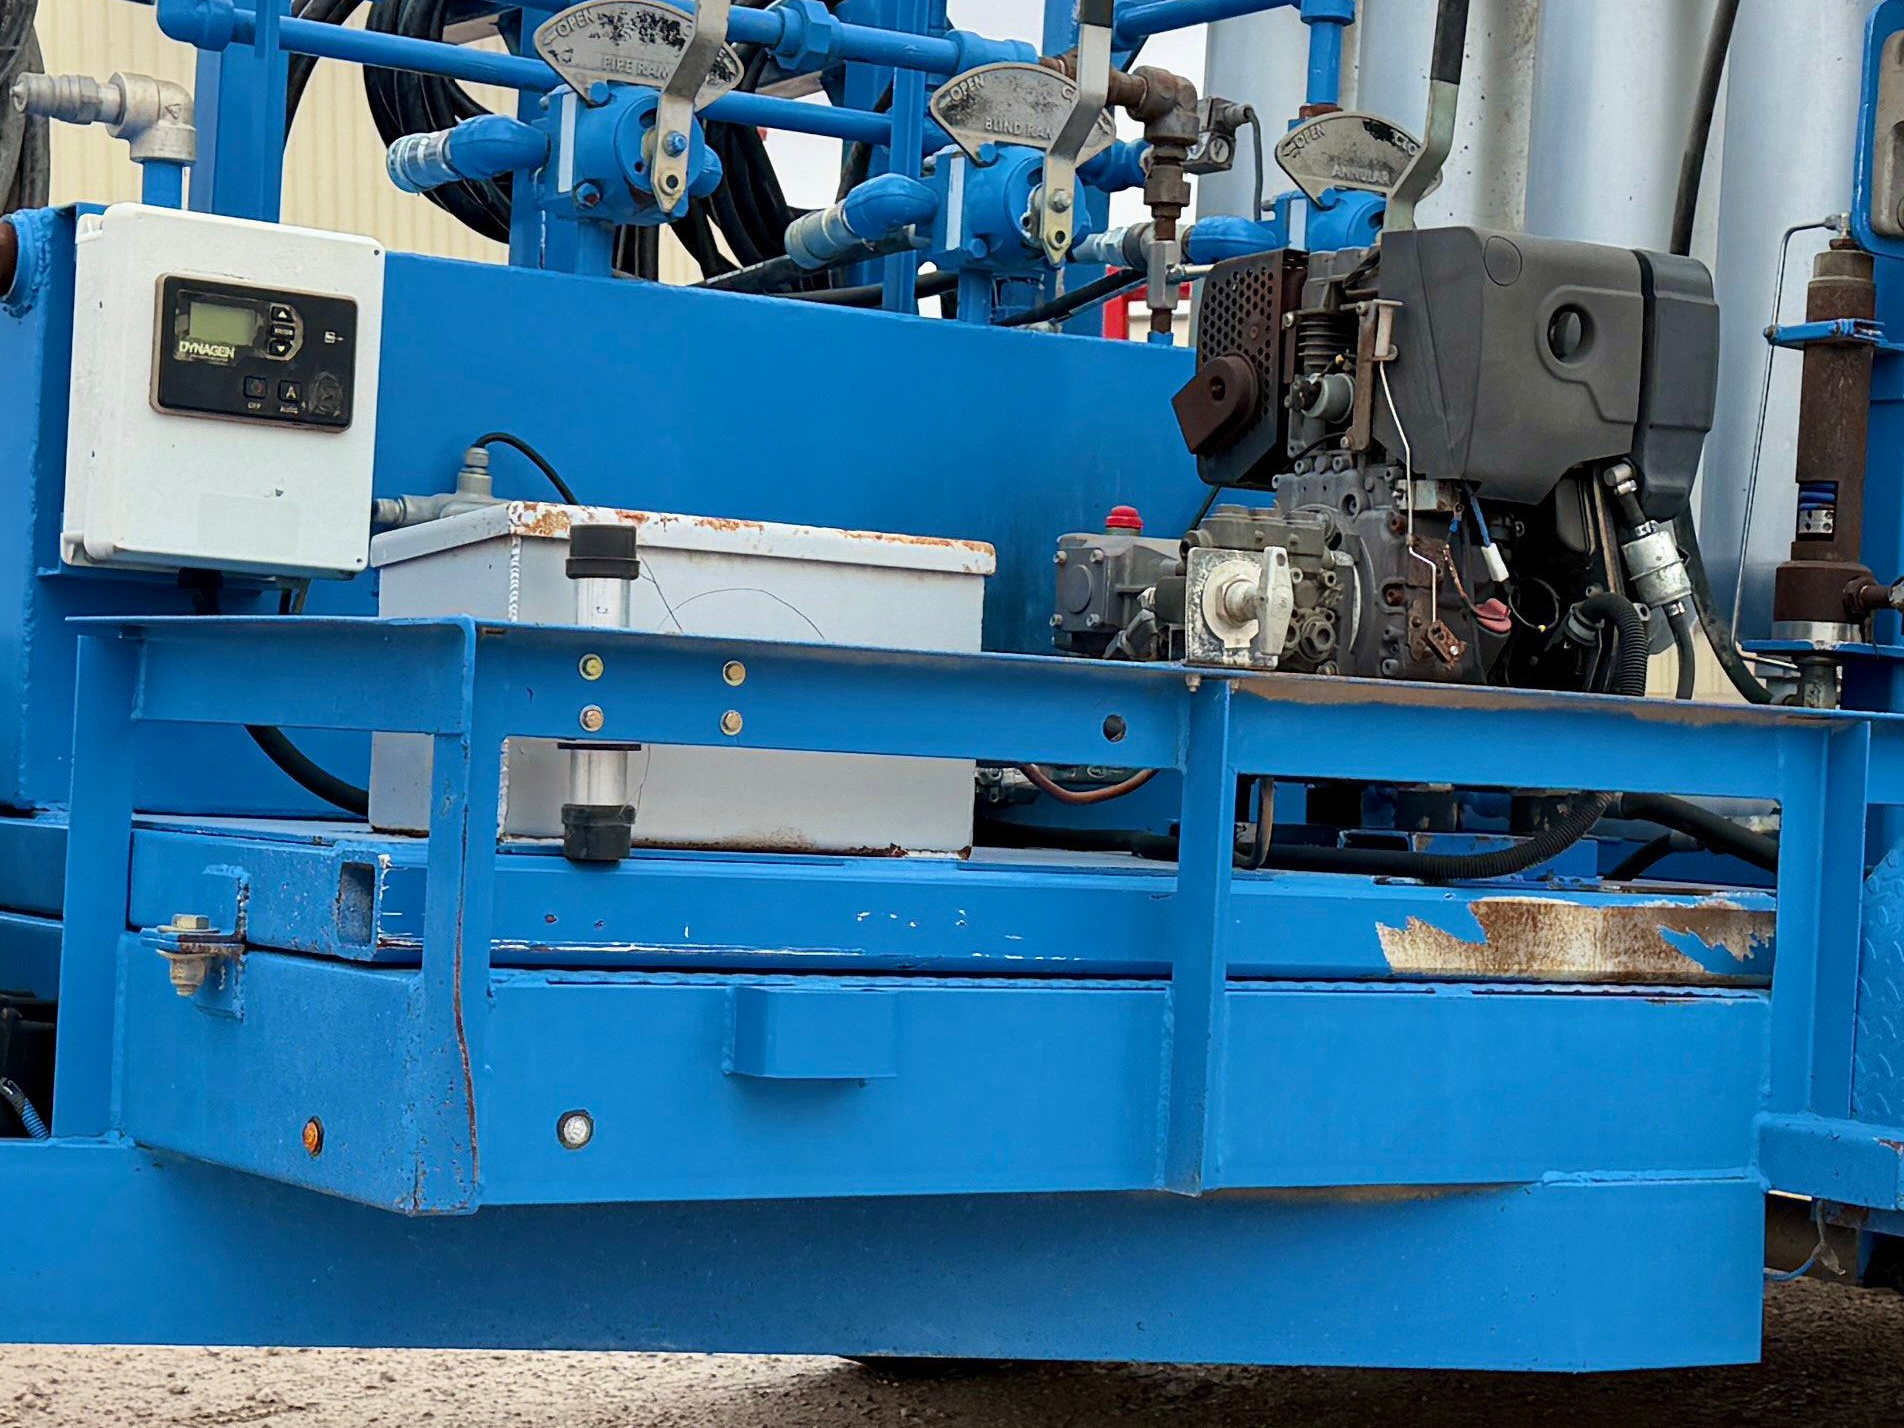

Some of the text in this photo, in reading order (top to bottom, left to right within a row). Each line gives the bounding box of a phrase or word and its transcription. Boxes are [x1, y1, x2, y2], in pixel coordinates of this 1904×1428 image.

[555, 9, 599, 37] OPEN
[604, 55, 632, 74] PIPE
[949, 75, 985, 102] OPEN
[985, 117, 1021, 135] BLIND
[1294, 124, 1325, 148] OPEN
[1332, 165, 1391, 184] ANNULAR
[179, 340, 236, 359] DYNAGEN
